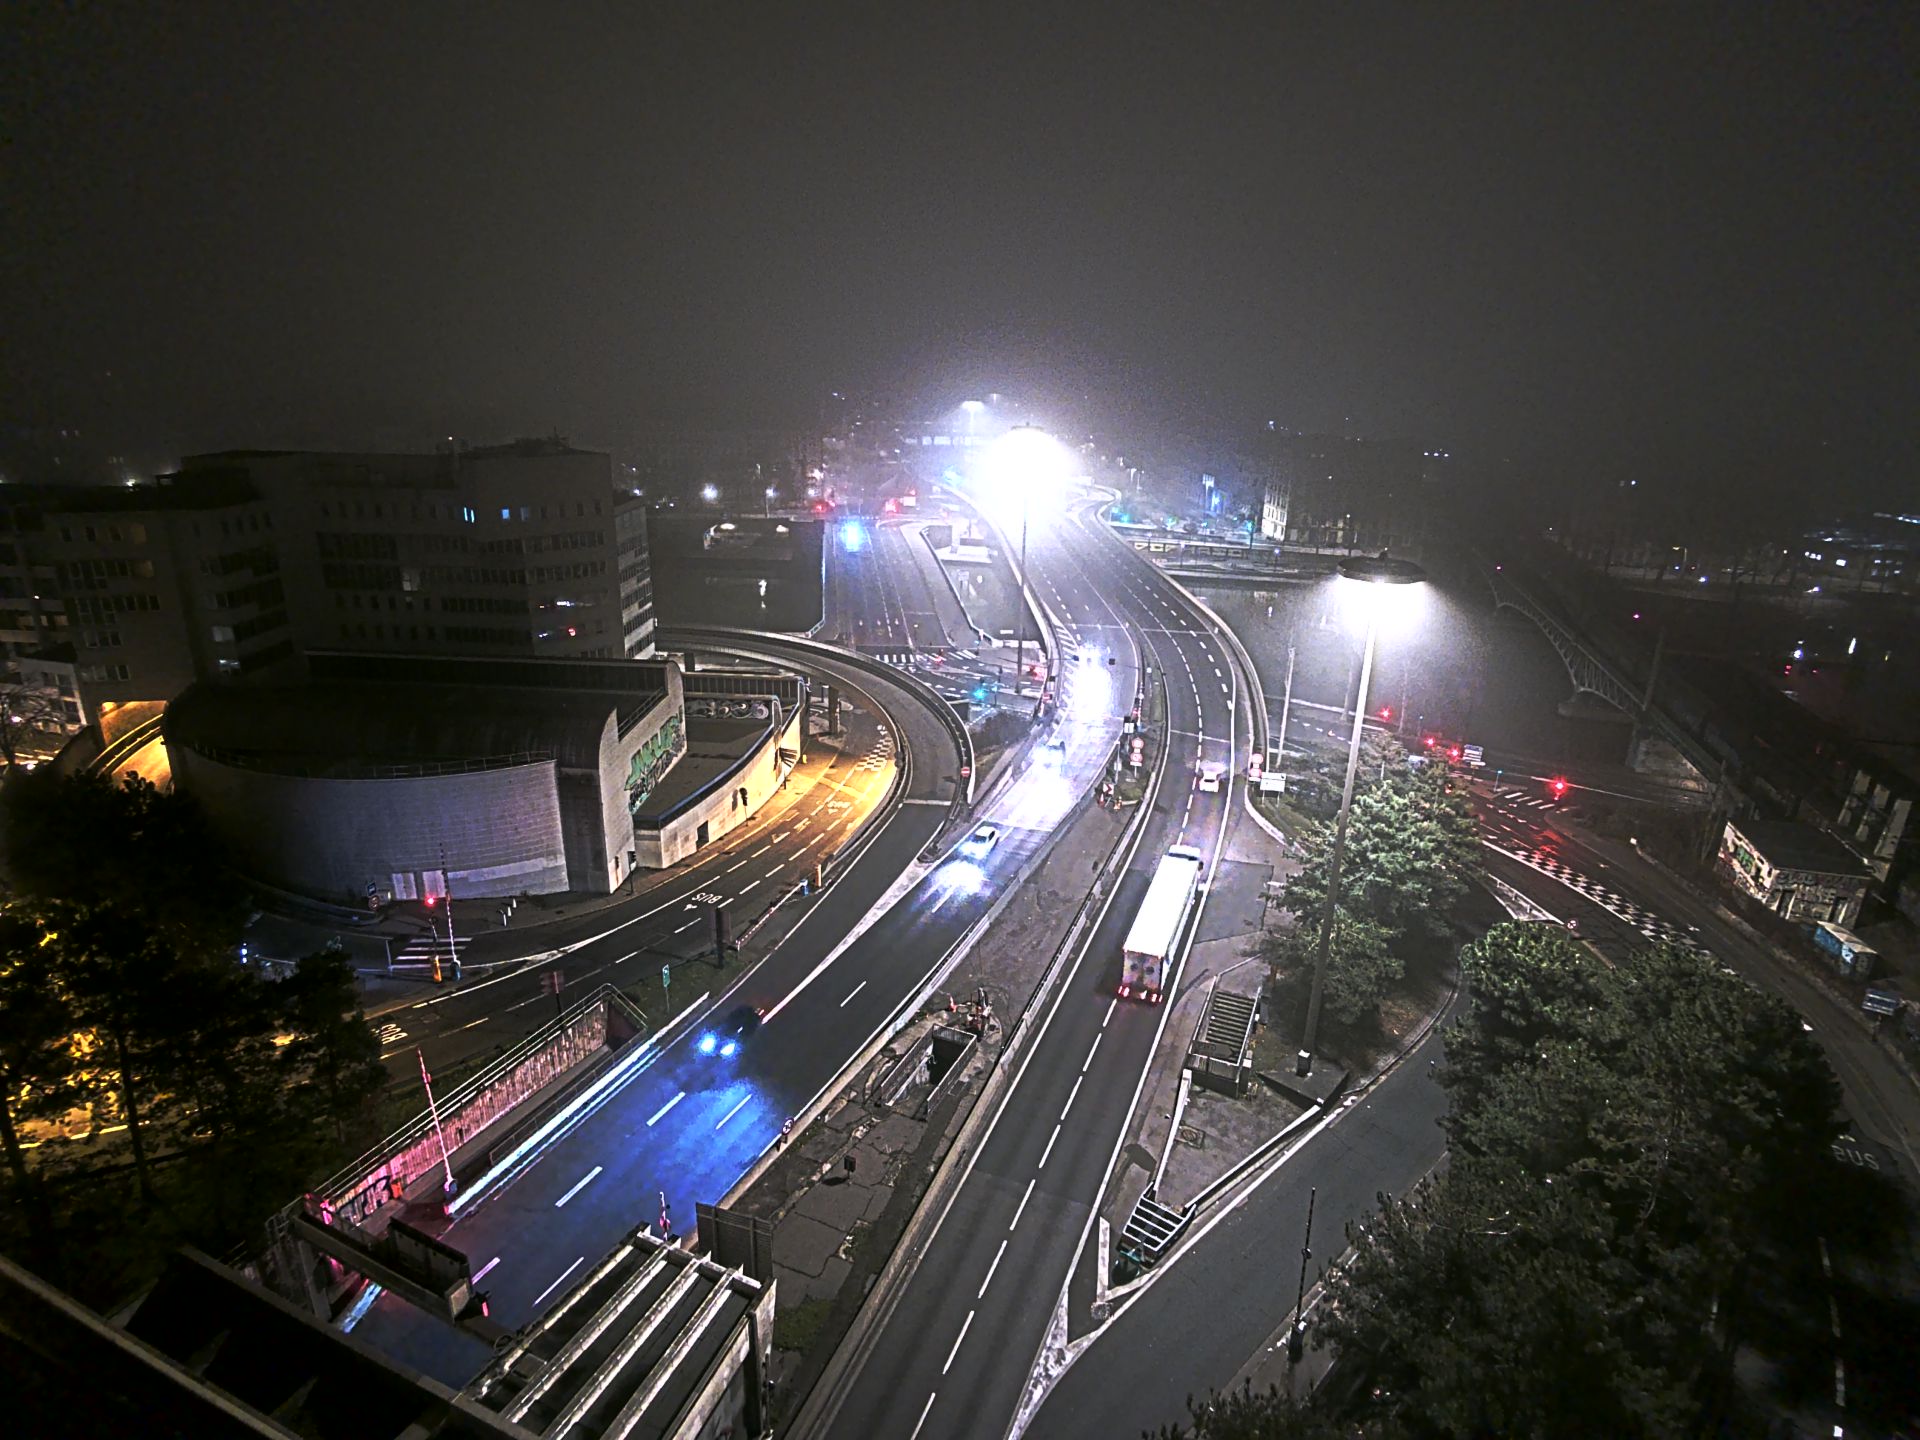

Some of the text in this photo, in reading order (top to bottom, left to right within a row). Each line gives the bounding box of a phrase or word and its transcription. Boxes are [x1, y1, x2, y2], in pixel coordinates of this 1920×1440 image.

[692, 892, 722, 903] BUS
[381, 1023, 408, 1044] BUS
[1831, 1144, 1879, 1169] BUS
